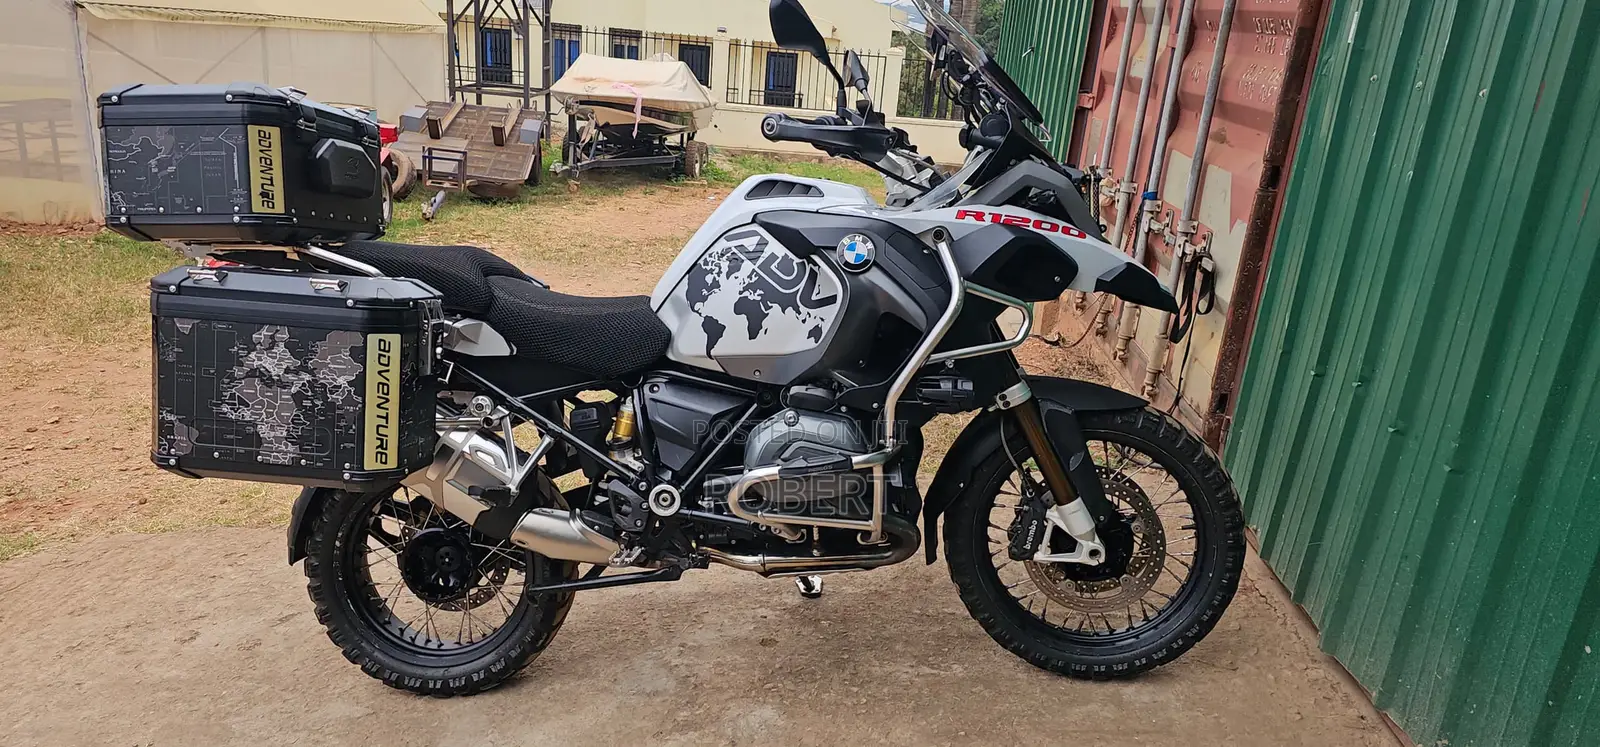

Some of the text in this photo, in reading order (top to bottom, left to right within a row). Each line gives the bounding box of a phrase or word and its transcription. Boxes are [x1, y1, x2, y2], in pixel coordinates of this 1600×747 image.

[954, 209, 1088, 240] R1200
[842, 235, 873, 250] BMW
[723, 229, 838, 310] ADV
[1022, 519, 1038, 550] brembo
